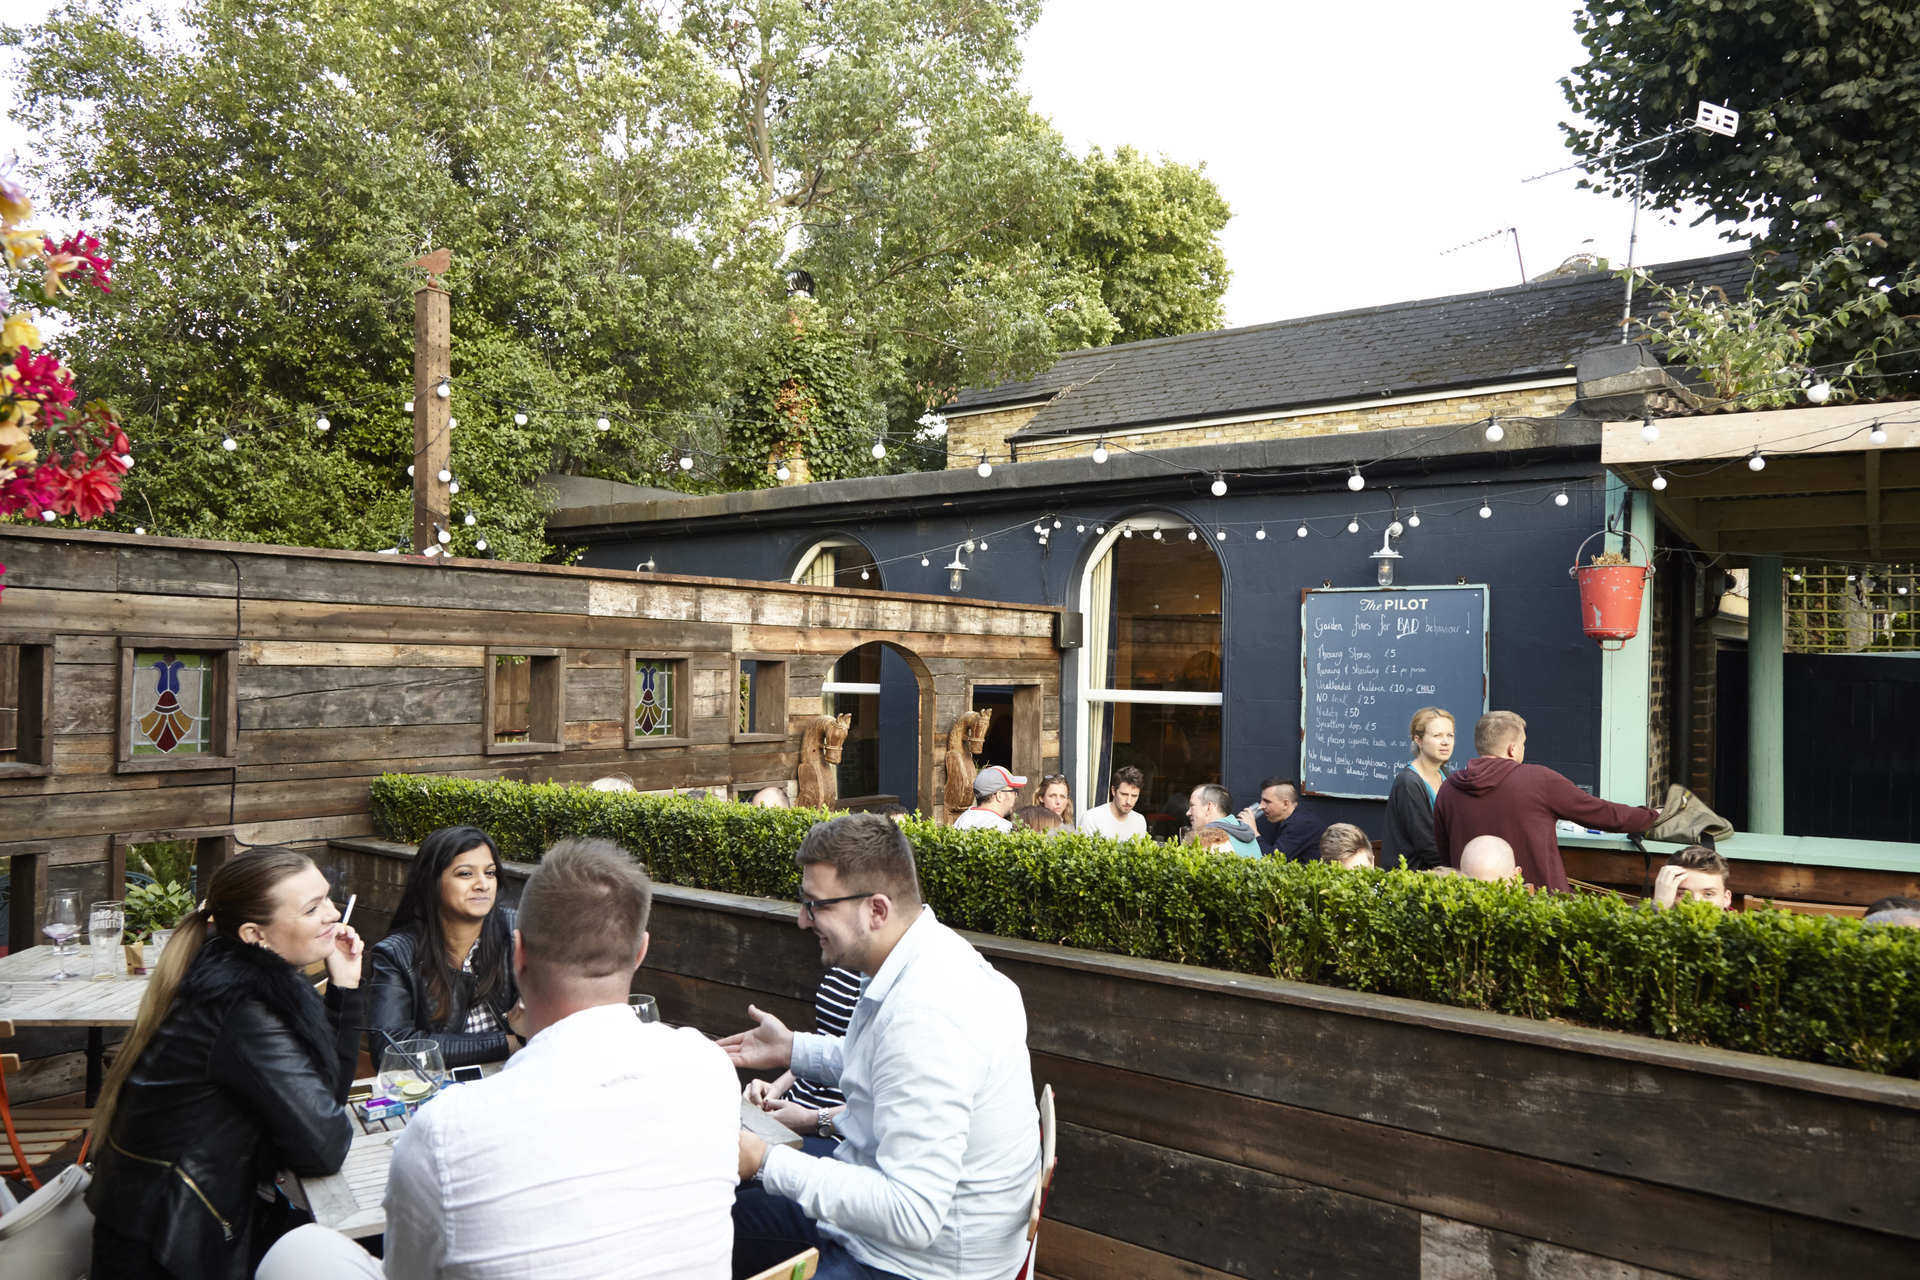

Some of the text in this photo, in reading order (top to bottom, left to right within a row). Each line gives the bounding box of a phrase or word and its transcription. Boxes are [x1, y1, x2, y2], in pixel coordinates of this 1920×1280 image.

[1360, 599, 1429, 611] The PILOT
[1314, 616, 1343, 638] Garden
[1352, 614, 1372, 637] fines
[1378, 613, 1391, 636] for
[1397, 617, 1419, 637] BAD
[1416, 684, 1436, 694] CHILD
[1316, 693, 1328, 703] NO
[1344, 707, 1360, 718] £50
